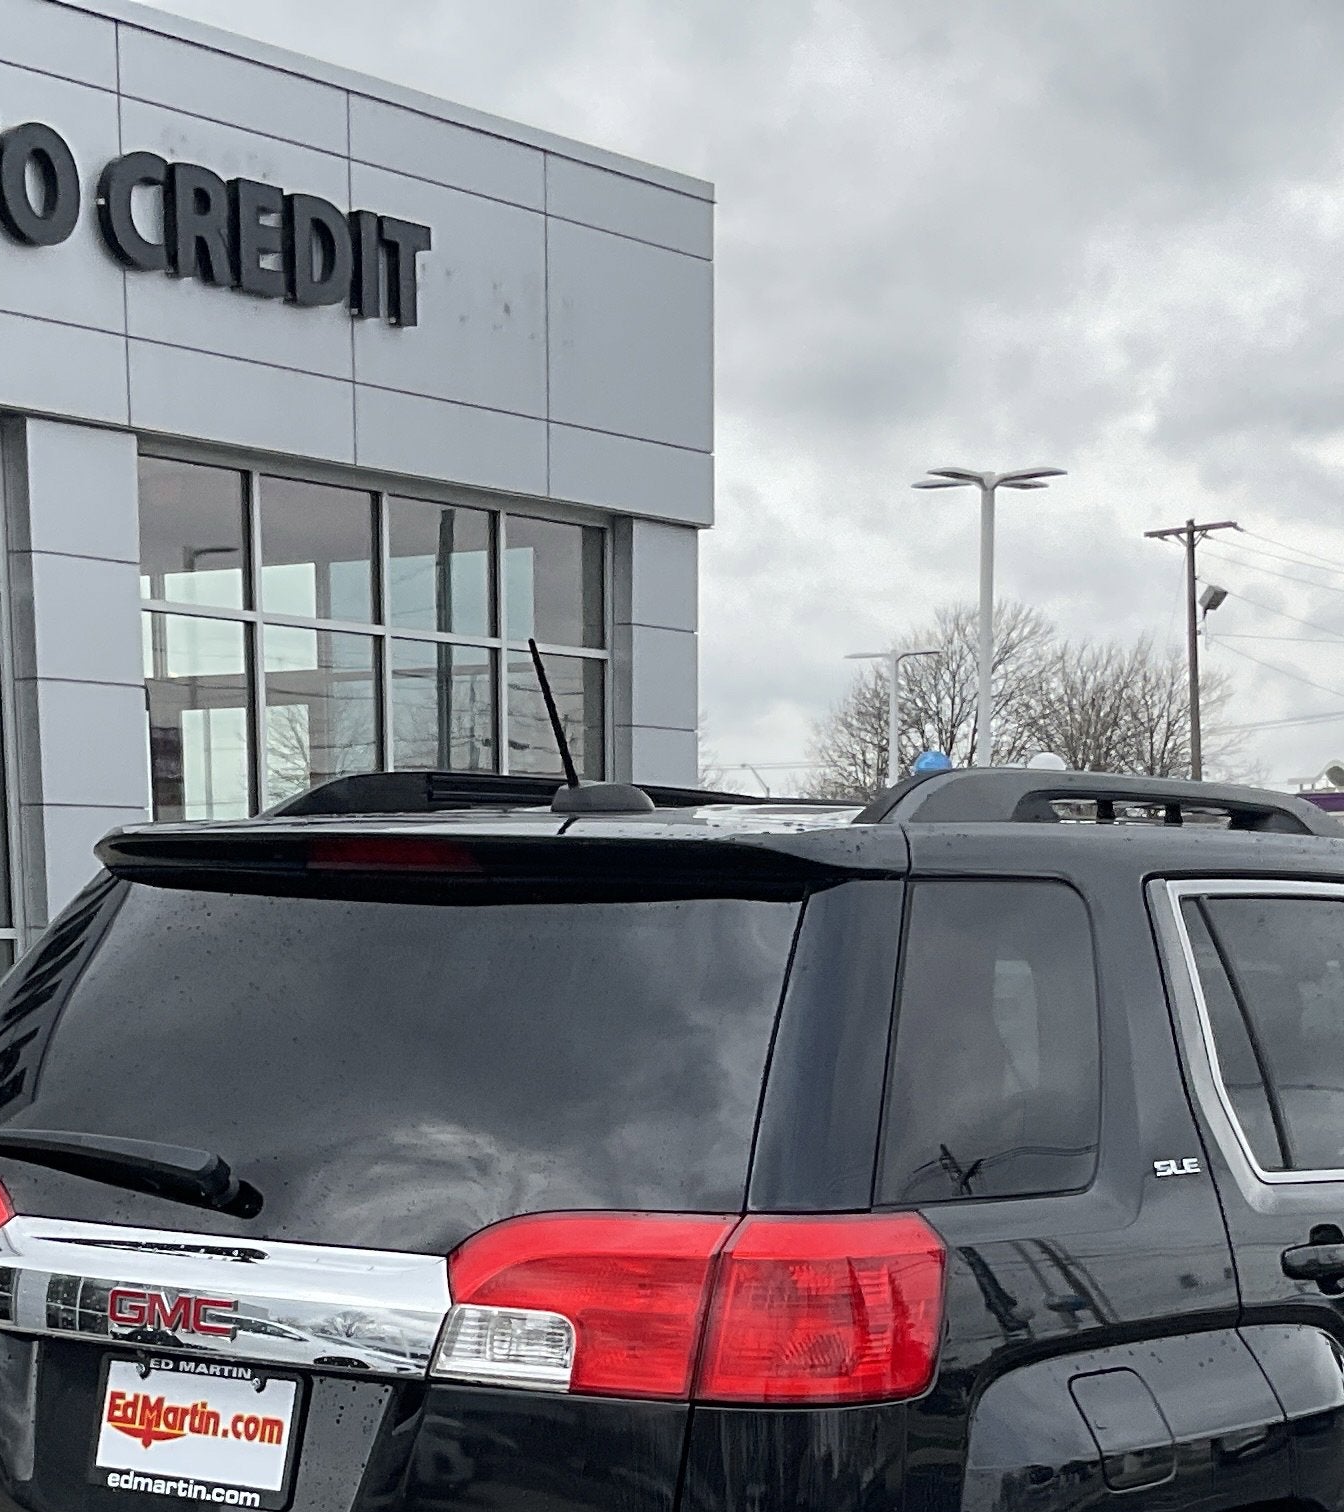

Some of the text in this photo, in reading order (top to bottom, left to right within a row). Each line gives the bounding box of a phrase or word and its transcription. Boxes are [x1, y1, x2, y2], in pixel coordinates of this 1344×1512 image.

[97, 152, 432, 327] CREDIT
[1153, 1157, 1201, 1177] SLE
[108, 1287, 239, 1342] GMC
[149, 1358, 252, 1380] ED MARTIN
[107, 1391, 284, 1446] EdMartin.com
[107, 1471, 260, 1507] edmartin.com
